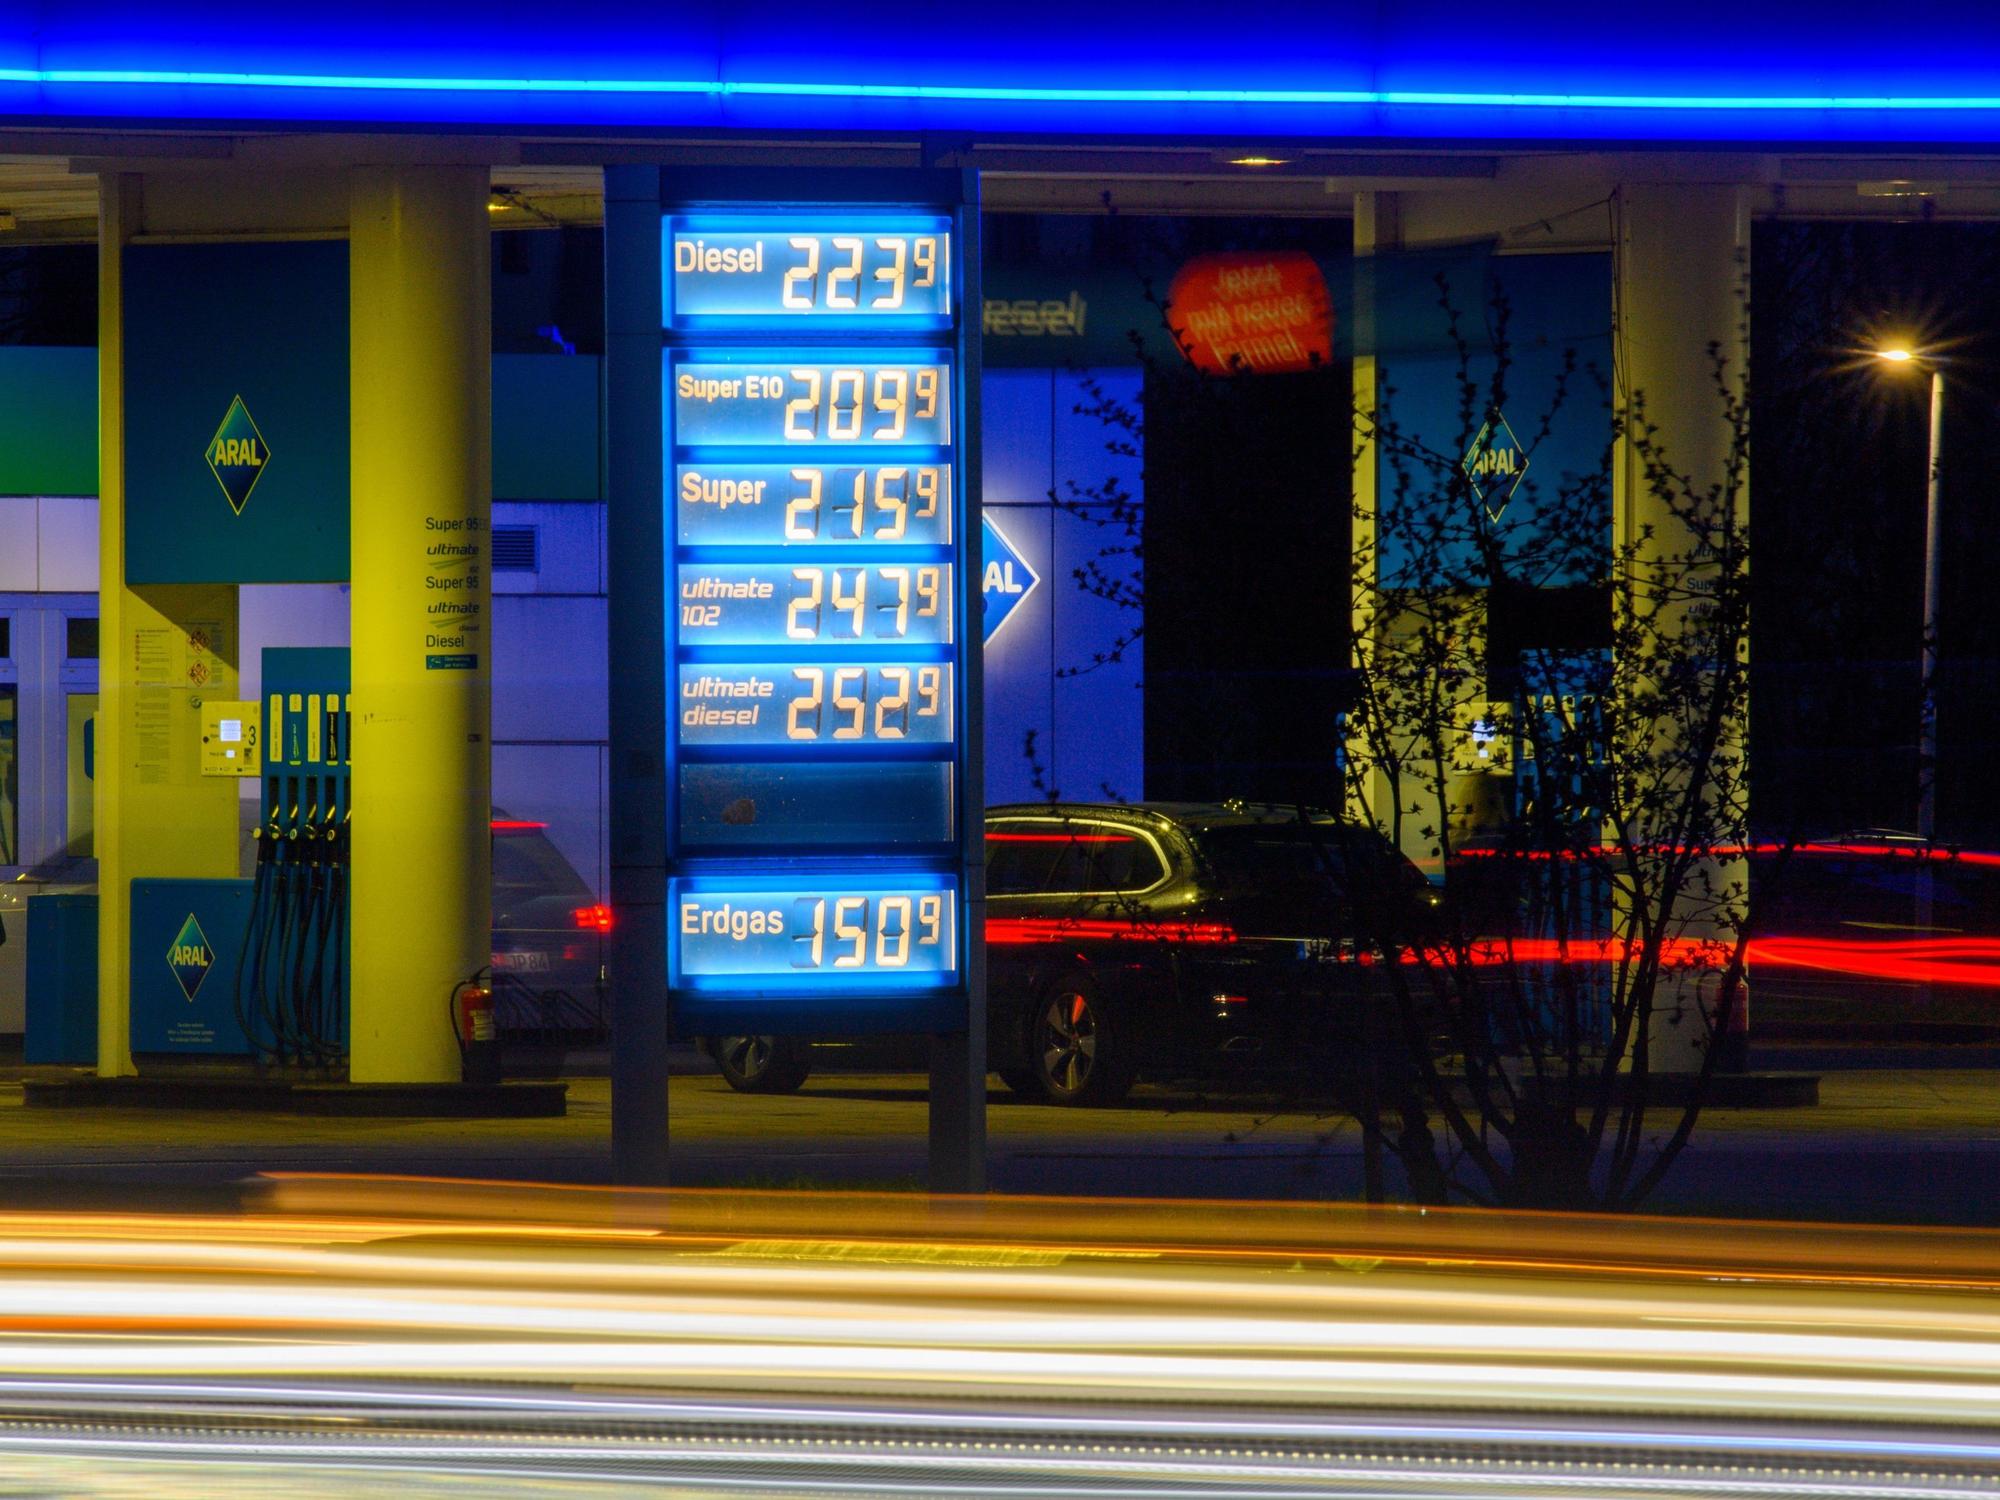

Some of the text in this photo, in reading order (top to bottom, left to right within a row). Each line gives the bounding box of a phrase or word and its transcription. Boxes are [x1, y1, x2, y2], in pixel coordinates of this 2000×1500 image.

[675, 240, 763, 273] Diesel
[678, 374, 742, 402] Super
[745, 376, 784, 399] E10
[214, 438, 262, 466] ARAL
[1472, 448, 1519, 475] ARAL
[682, 472, 767, 510] Super
[425, 517, 463, 532] Super
[427, 543, 479, 556] ultimate
[425, 576, 479, 591] Super 95
[682, 578, 774, 598] ultimate
[982, 561, 1023, 593] AL
[427, 602, 480, 614] ultimate
[682, 605, 721, 627] 102
[425, 635, 465, 648] Diesel
[682, 677, 774, 697] ultimate
[683, 704, 760, 726] diesel
[248, 725, 257, 746] 3
[681, 904, 784, 941] Erdgas
[173, 945, 209, 967] ARAL
